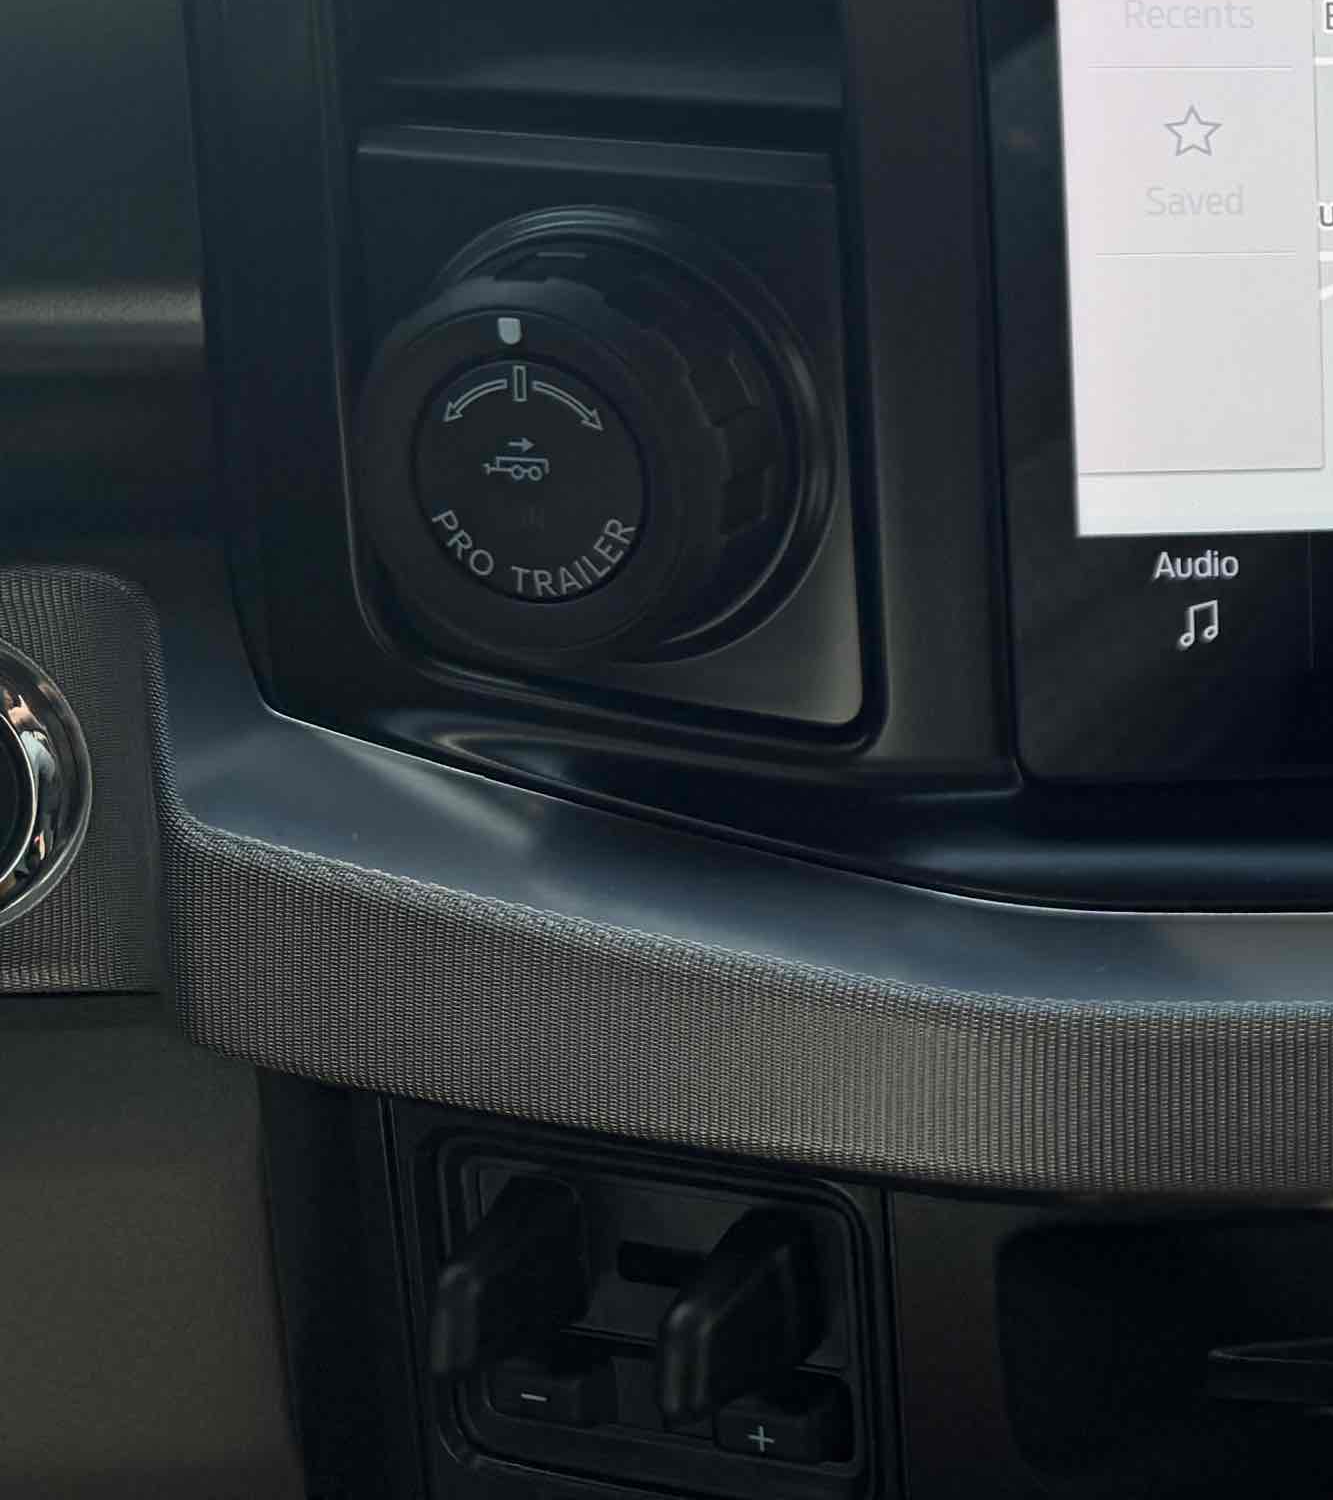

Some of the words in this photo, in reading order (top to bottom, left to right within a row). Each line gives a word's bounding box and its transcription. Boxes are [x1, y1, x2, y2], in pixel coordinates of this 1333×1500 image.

[1123, 0, 1256, 31] Recents
[1145, 184, 1245, 217] Saved
[431, 508, 496, 578] PRO
[510, 516, 638, 598] TRAILER
[1153, 549, 1240, 581] Audio
